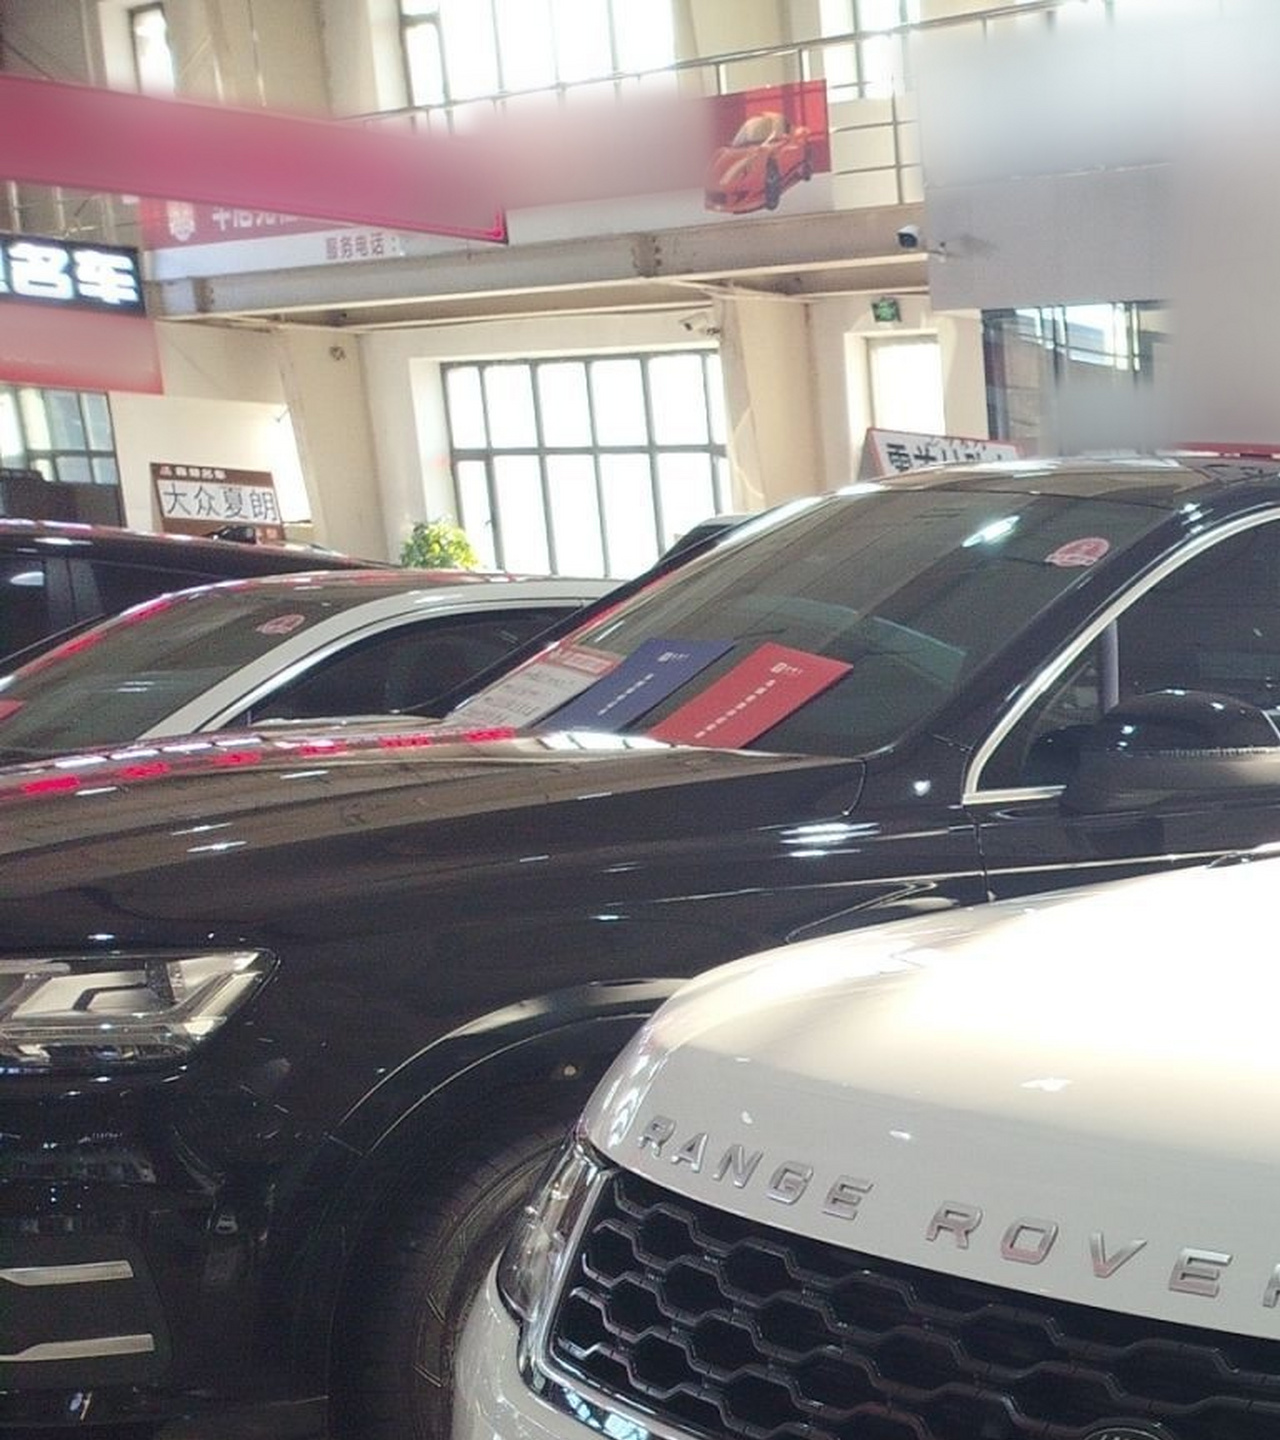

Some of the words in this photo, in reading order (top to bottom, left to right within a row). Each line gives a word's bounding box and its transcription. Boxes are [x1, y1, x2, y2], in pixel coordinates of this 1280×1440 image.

[0, 242, 140, 305] 名车
[163, 482, 278, 521] 大众夏朗
[637, 1115, 875, 1220] RANGE
